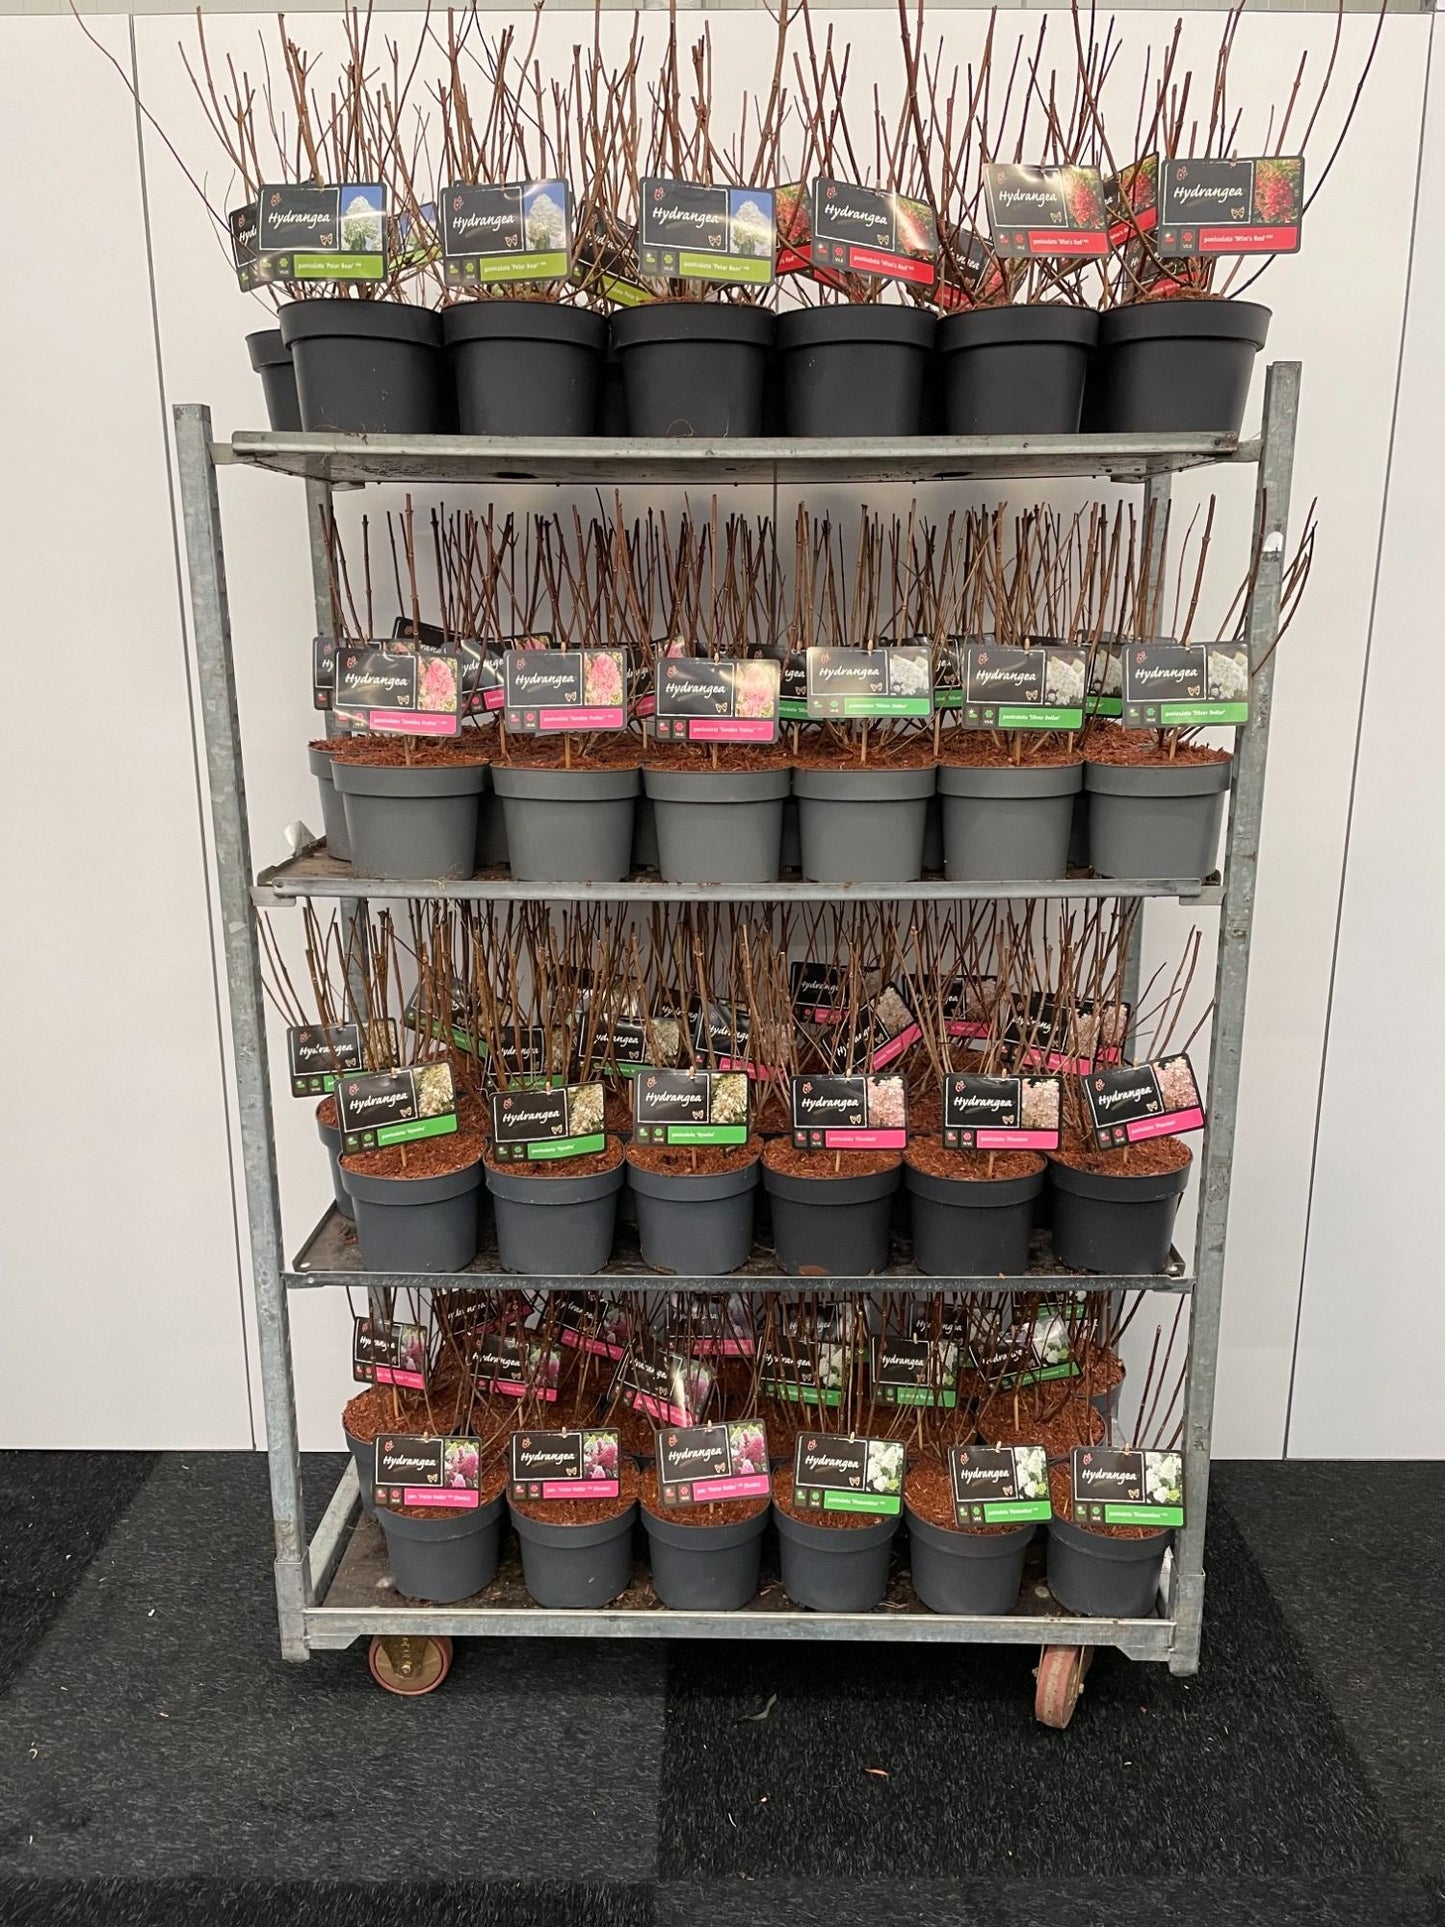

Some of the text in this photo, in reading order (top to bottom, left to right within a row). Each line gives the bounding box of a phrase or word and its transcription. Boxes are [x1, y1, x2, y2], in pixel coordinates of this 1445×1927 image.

[999, 189, 1057, 207] Hydrangea
[1173, 184, 1244, 204] Hydrangea
[268, 210, 331, 229] Hydrangea
[453, 213, 515, 234] Hydrangea
[652, 206, 720, 229] Hydrangea
[824, 204, 888, 227] Hydrangea
[345, 673, 408, 690] Hydrangea
[515, 672, 576, 690] Hydrangea
[819, 665, 880, 681] Hydrangea
[976, 669, 1037, 686] Hydrangea
[1135, 666, 1198, 684] Hydrangea
[665, 681, 727, 699] Hydrangea
[349, 1092, 408, 1114] Hydrangea
[645, 1091, 702, 1107] Hydrangea
[801, 1096, 859, 1112] Hydrangea
[953, 1095, 1013, 1112] Hydrangea
[1099, 1086, 1152, 1109] Hydrangea
[502, 1110, 560, 1127] Hydrangea
[383, 1454, 436, 1470] Hydrangea
[520, 1450, 575, 1466] Hydrangea
[668, 1447, 722, 1465] Hydrangea
[805, 1455, 859, 1472] Hydrangea
[960, 1467, 1009, 1484] Hydrangea
[1082, 1468, 1137, 1485] Hydrangea
